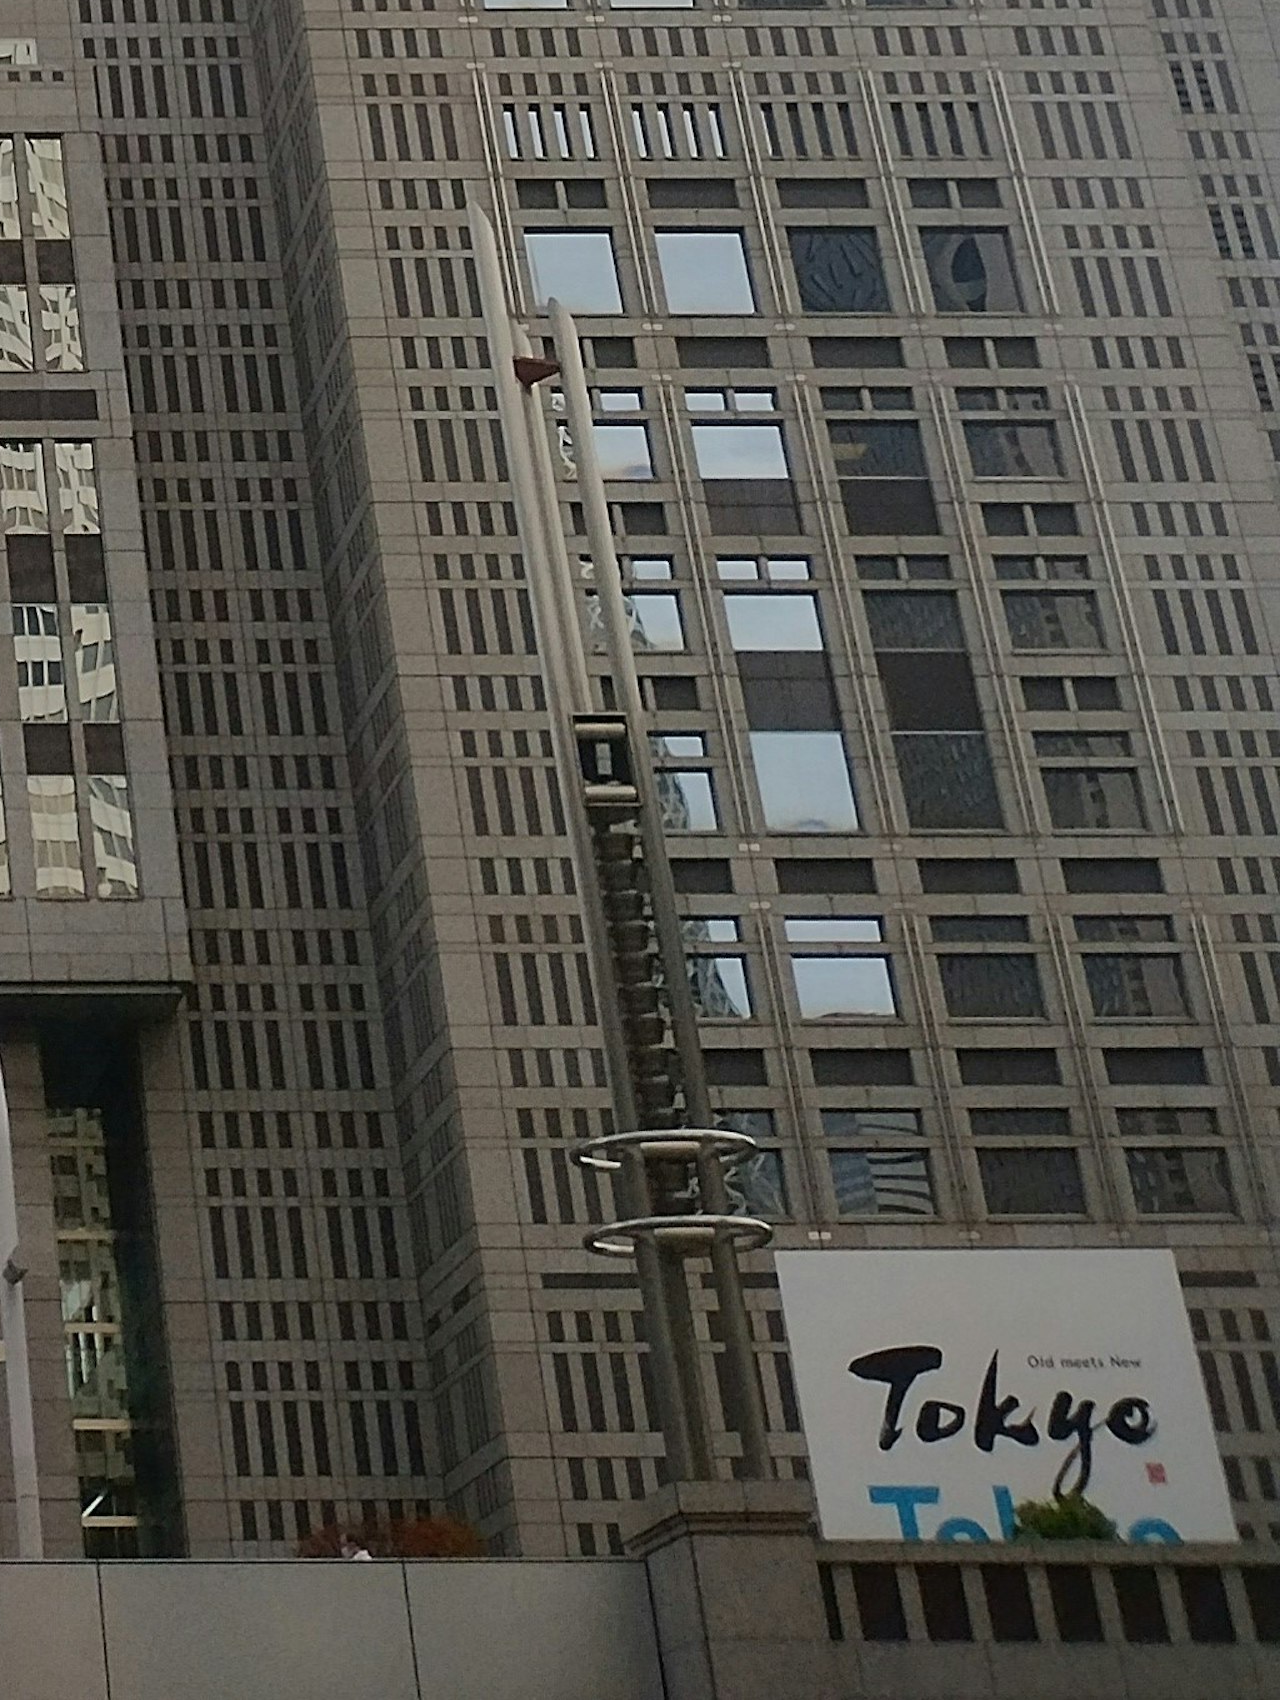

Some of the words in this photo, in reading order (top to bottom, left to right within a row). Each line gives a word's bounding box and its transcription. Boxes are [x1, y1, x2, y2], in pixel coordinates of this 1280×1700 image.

[1027, 1354, 1055, 1369] Old
[1060, 1356, 1105, 1369] meets
[1109, 1355, 1142, 1369] New
[847, 1345, 1158, 1506] Tokyo
